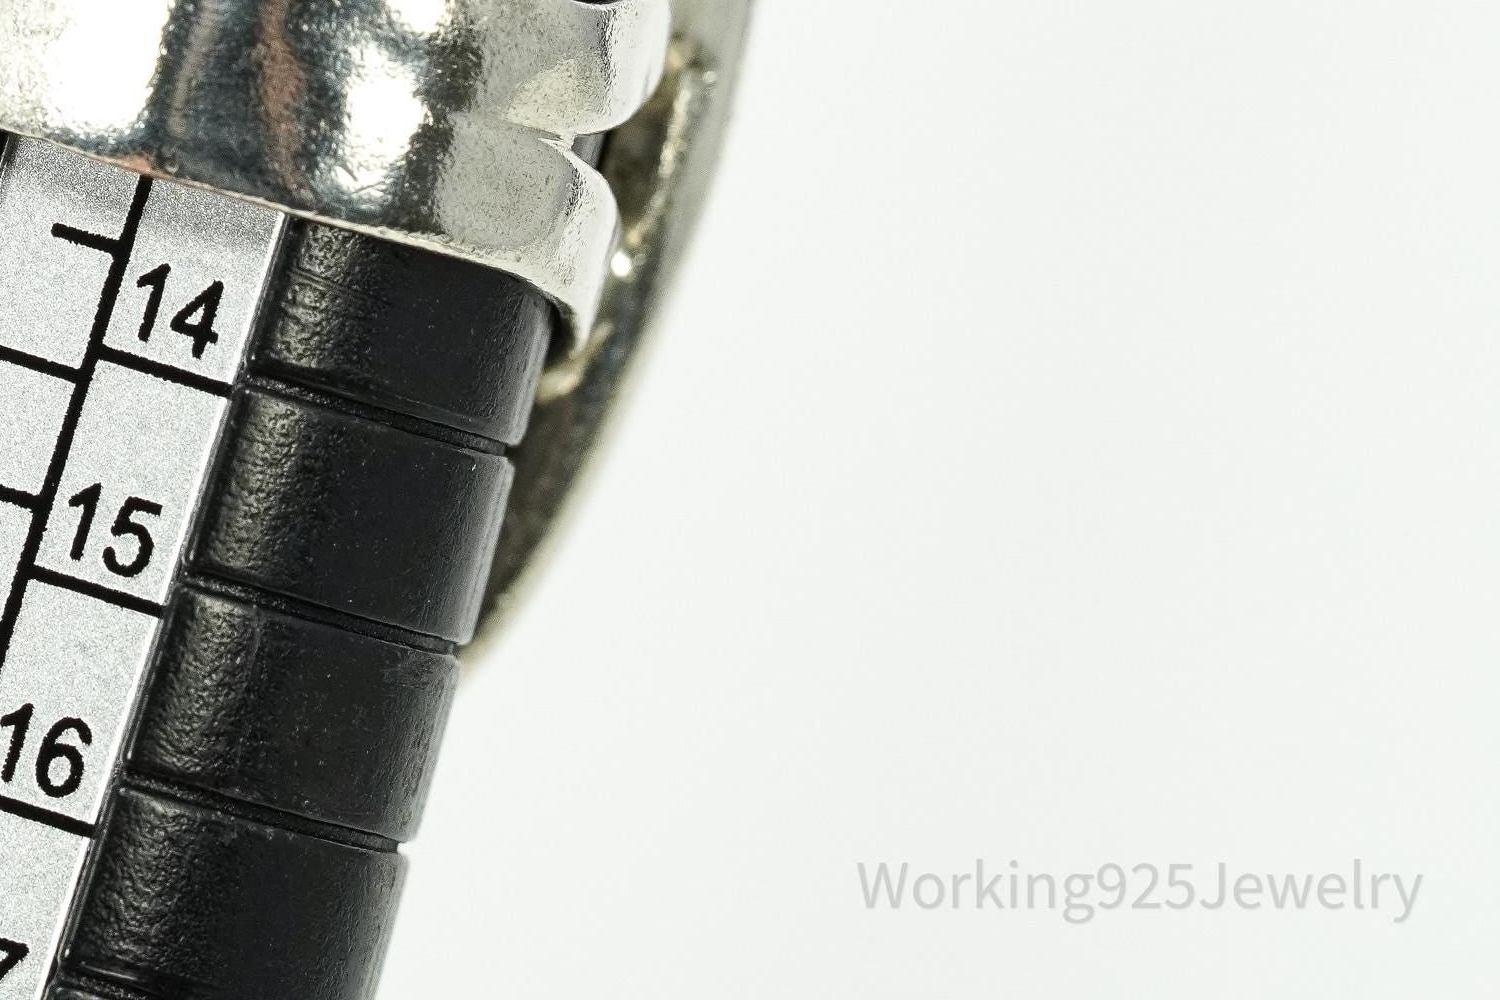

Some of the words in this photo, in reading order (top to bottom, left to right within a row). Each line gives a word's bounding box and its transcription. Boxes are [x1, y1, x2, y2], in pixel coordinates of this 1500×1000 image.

[136, 263, 225, 360] 14
[68, 482, 163, 578] 15
[0, 702, 93, 799] 16
